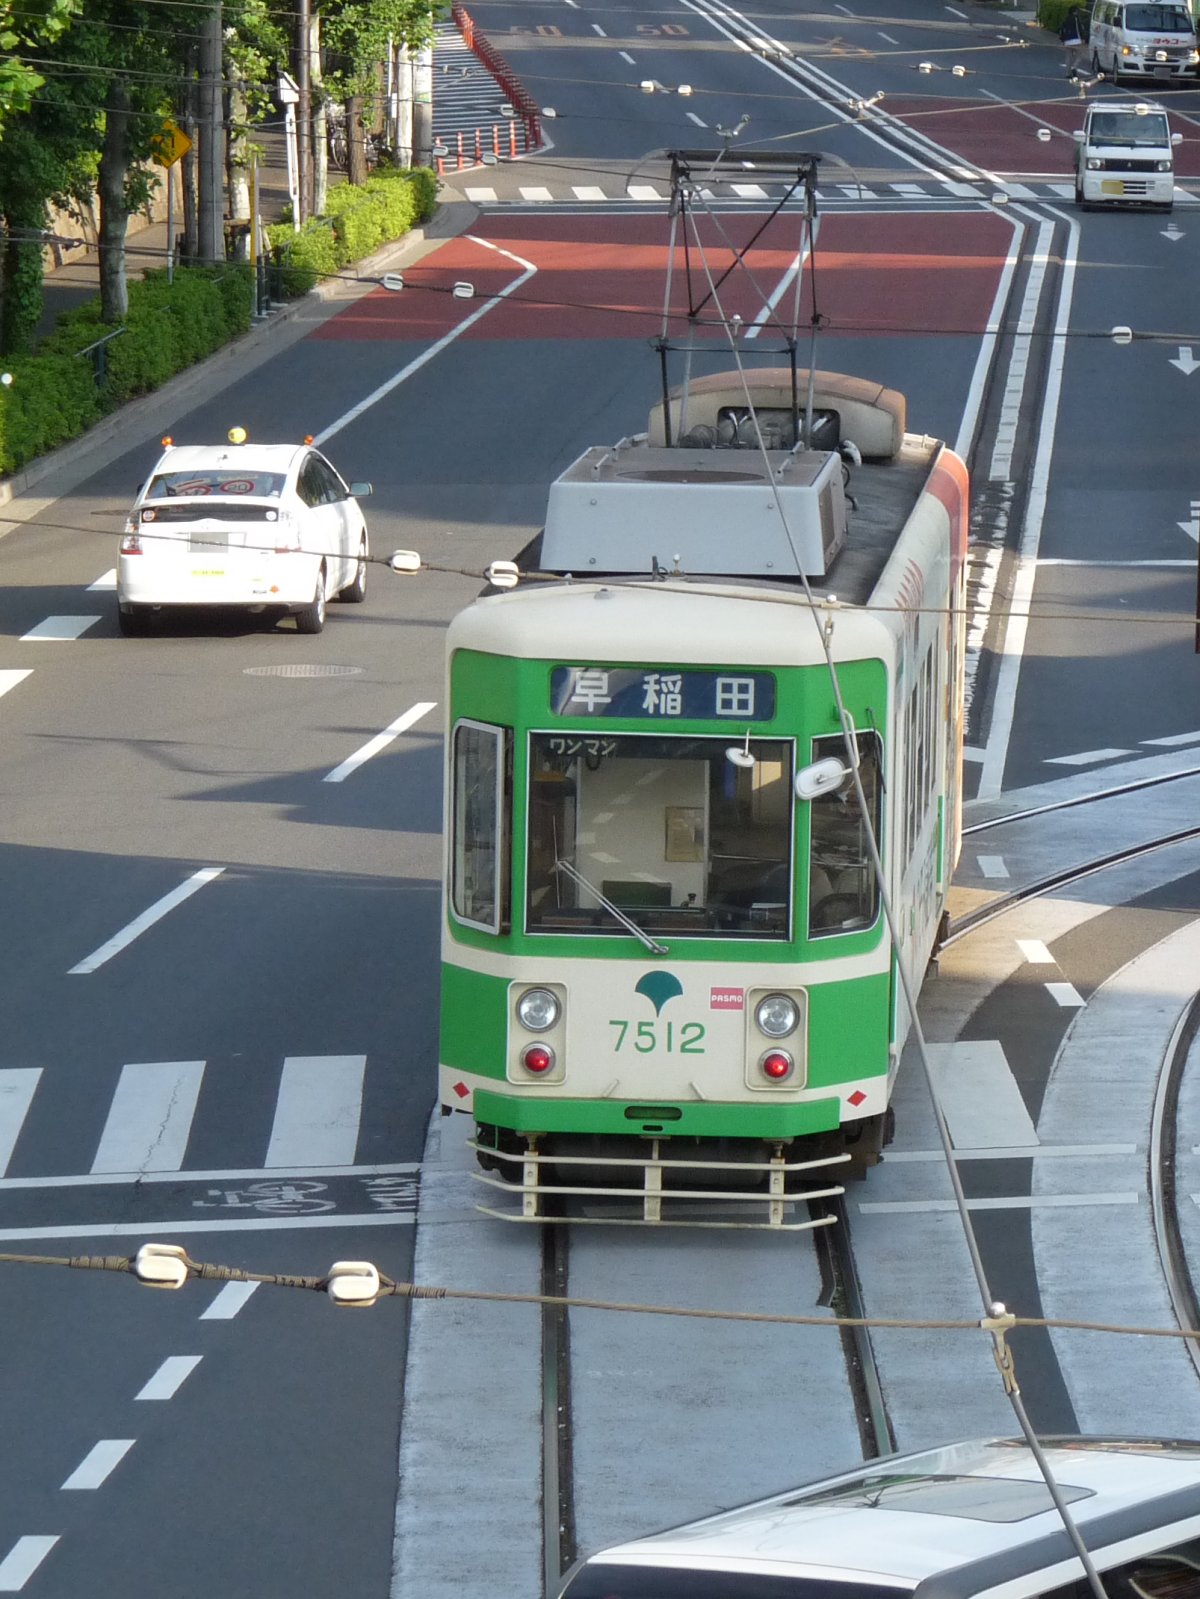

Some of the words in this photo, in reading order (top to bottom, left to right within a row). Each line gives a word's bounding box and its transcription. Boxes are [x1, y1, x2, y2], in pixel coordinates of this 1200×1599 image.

[571, 671, 755, 716] 早稲田
[550, 738, 616, 757] ワンマン
[711, 994, 743, 1003] PASMO
[609, 1019, 706, 1054] 7512
